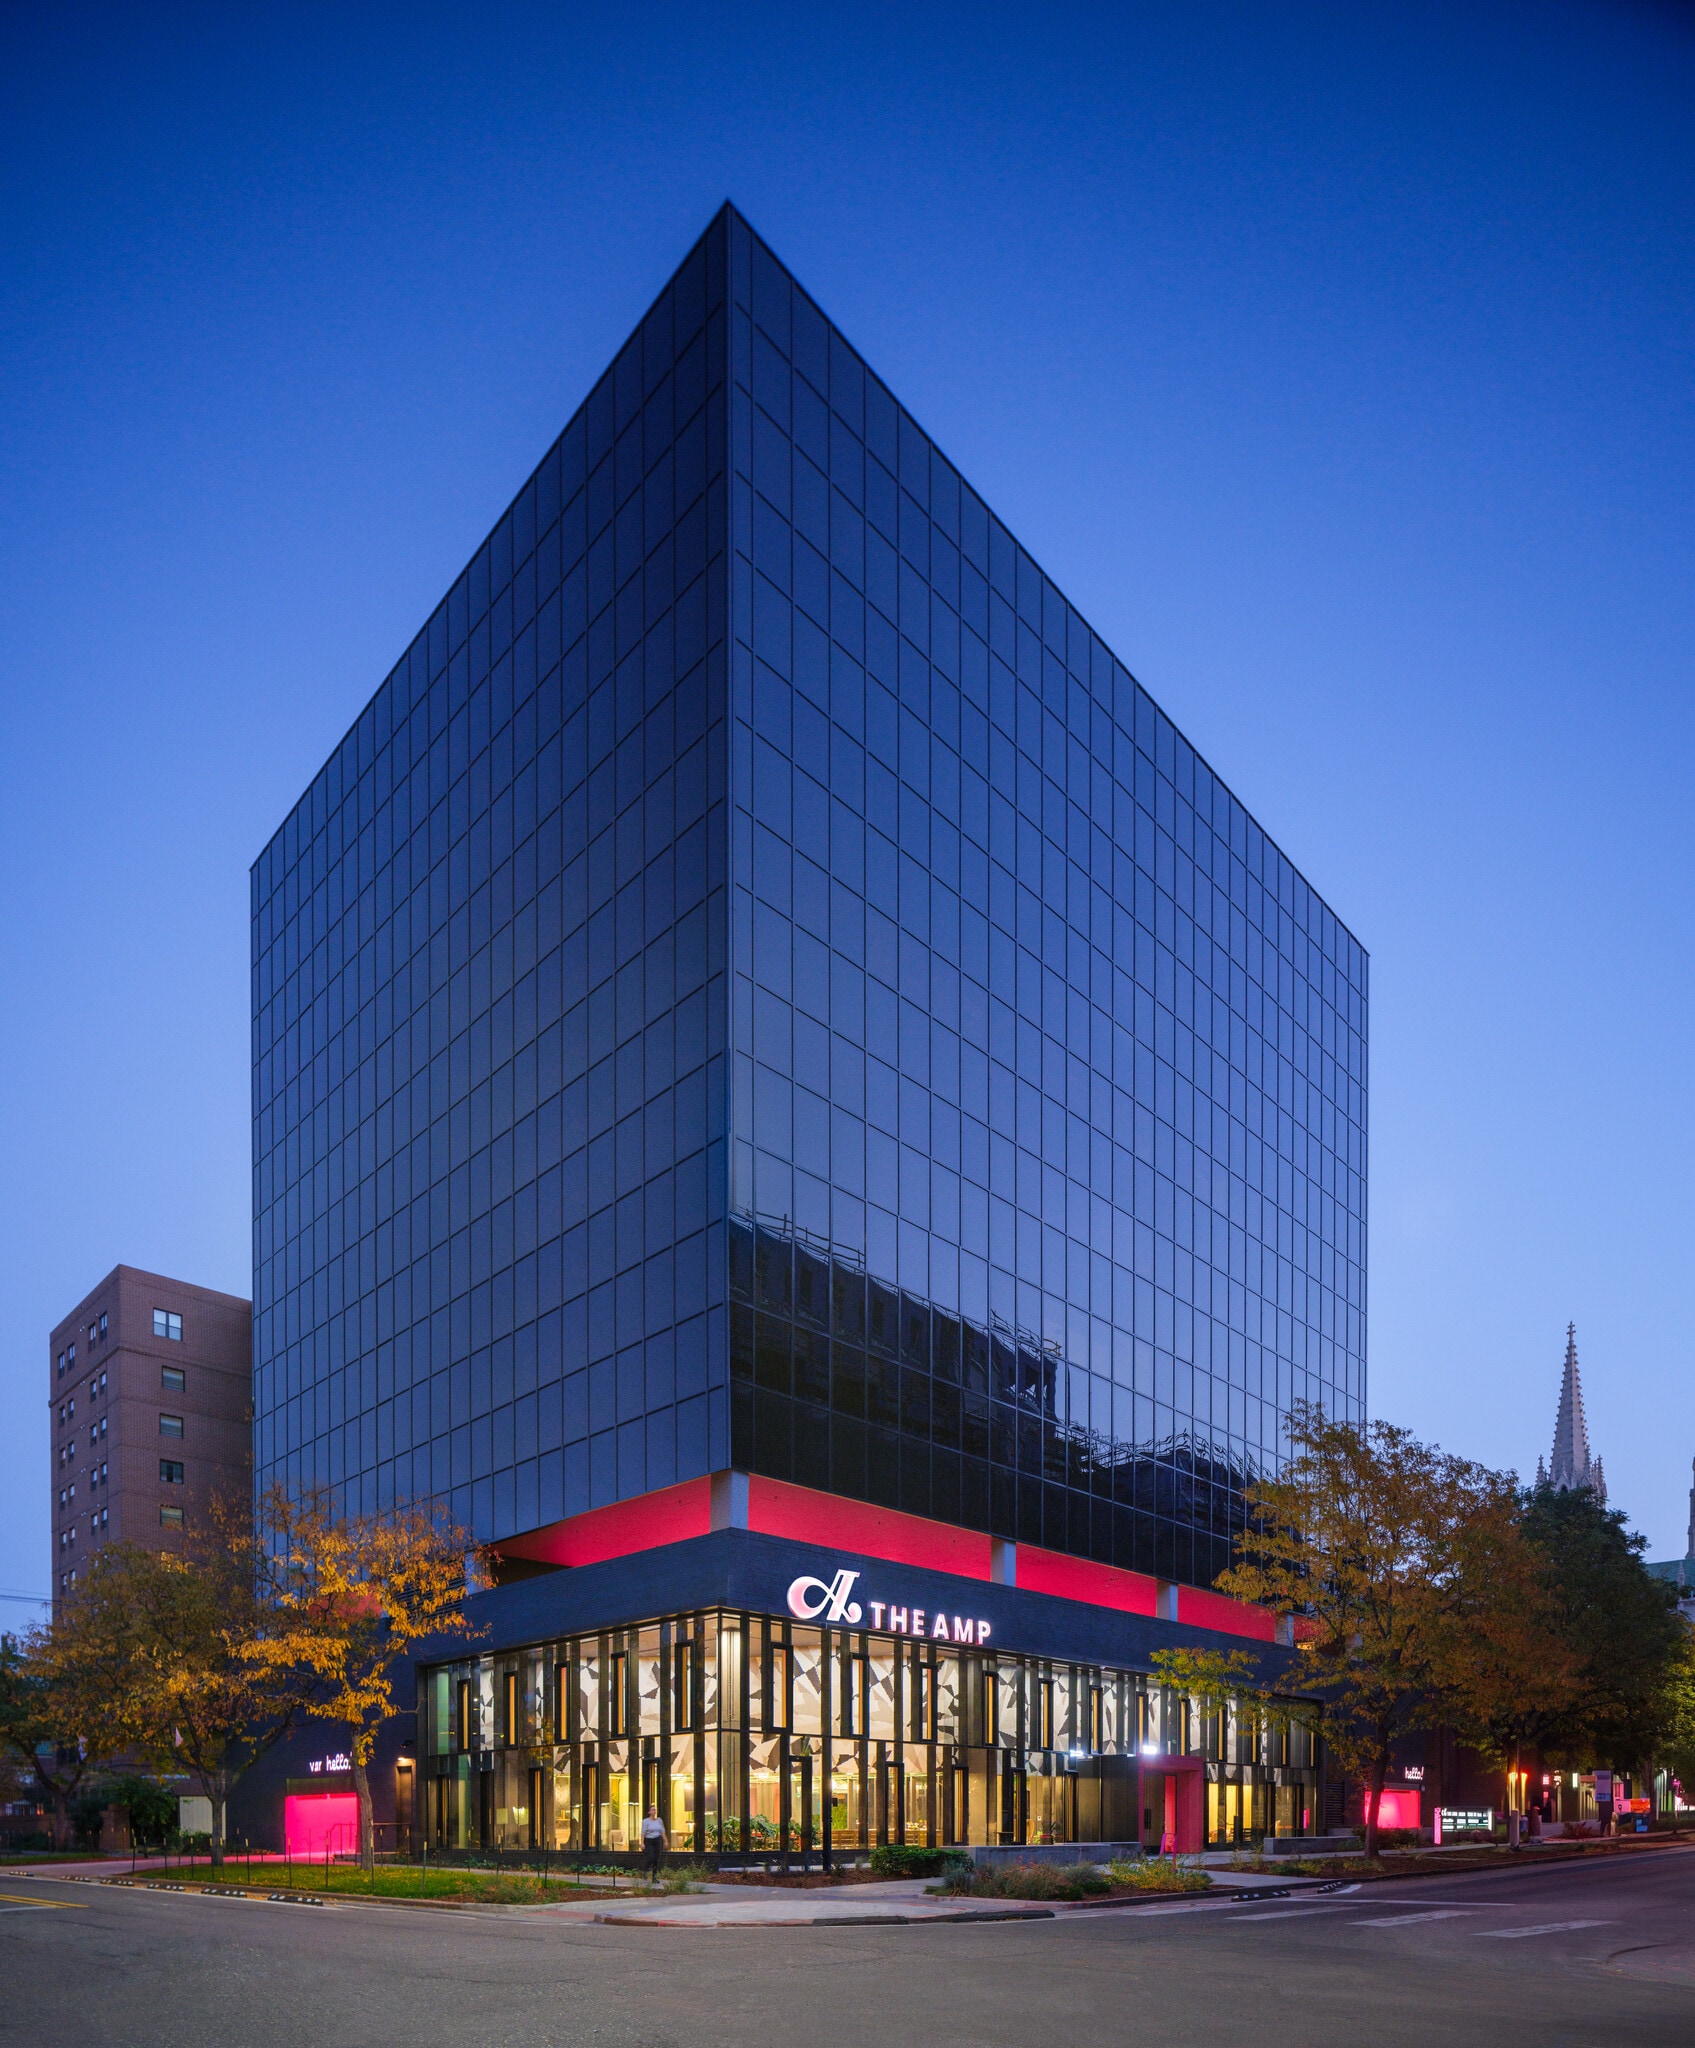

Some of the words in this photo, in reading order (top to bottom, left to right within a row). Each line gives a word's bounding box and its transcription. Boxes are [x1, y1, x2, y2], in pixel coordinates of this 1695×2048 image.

[870, 1602, 925, 1636] THE
[931, 1613, 991, 1645] AMP
[1405, 1766, 1424, 1780] hello!
